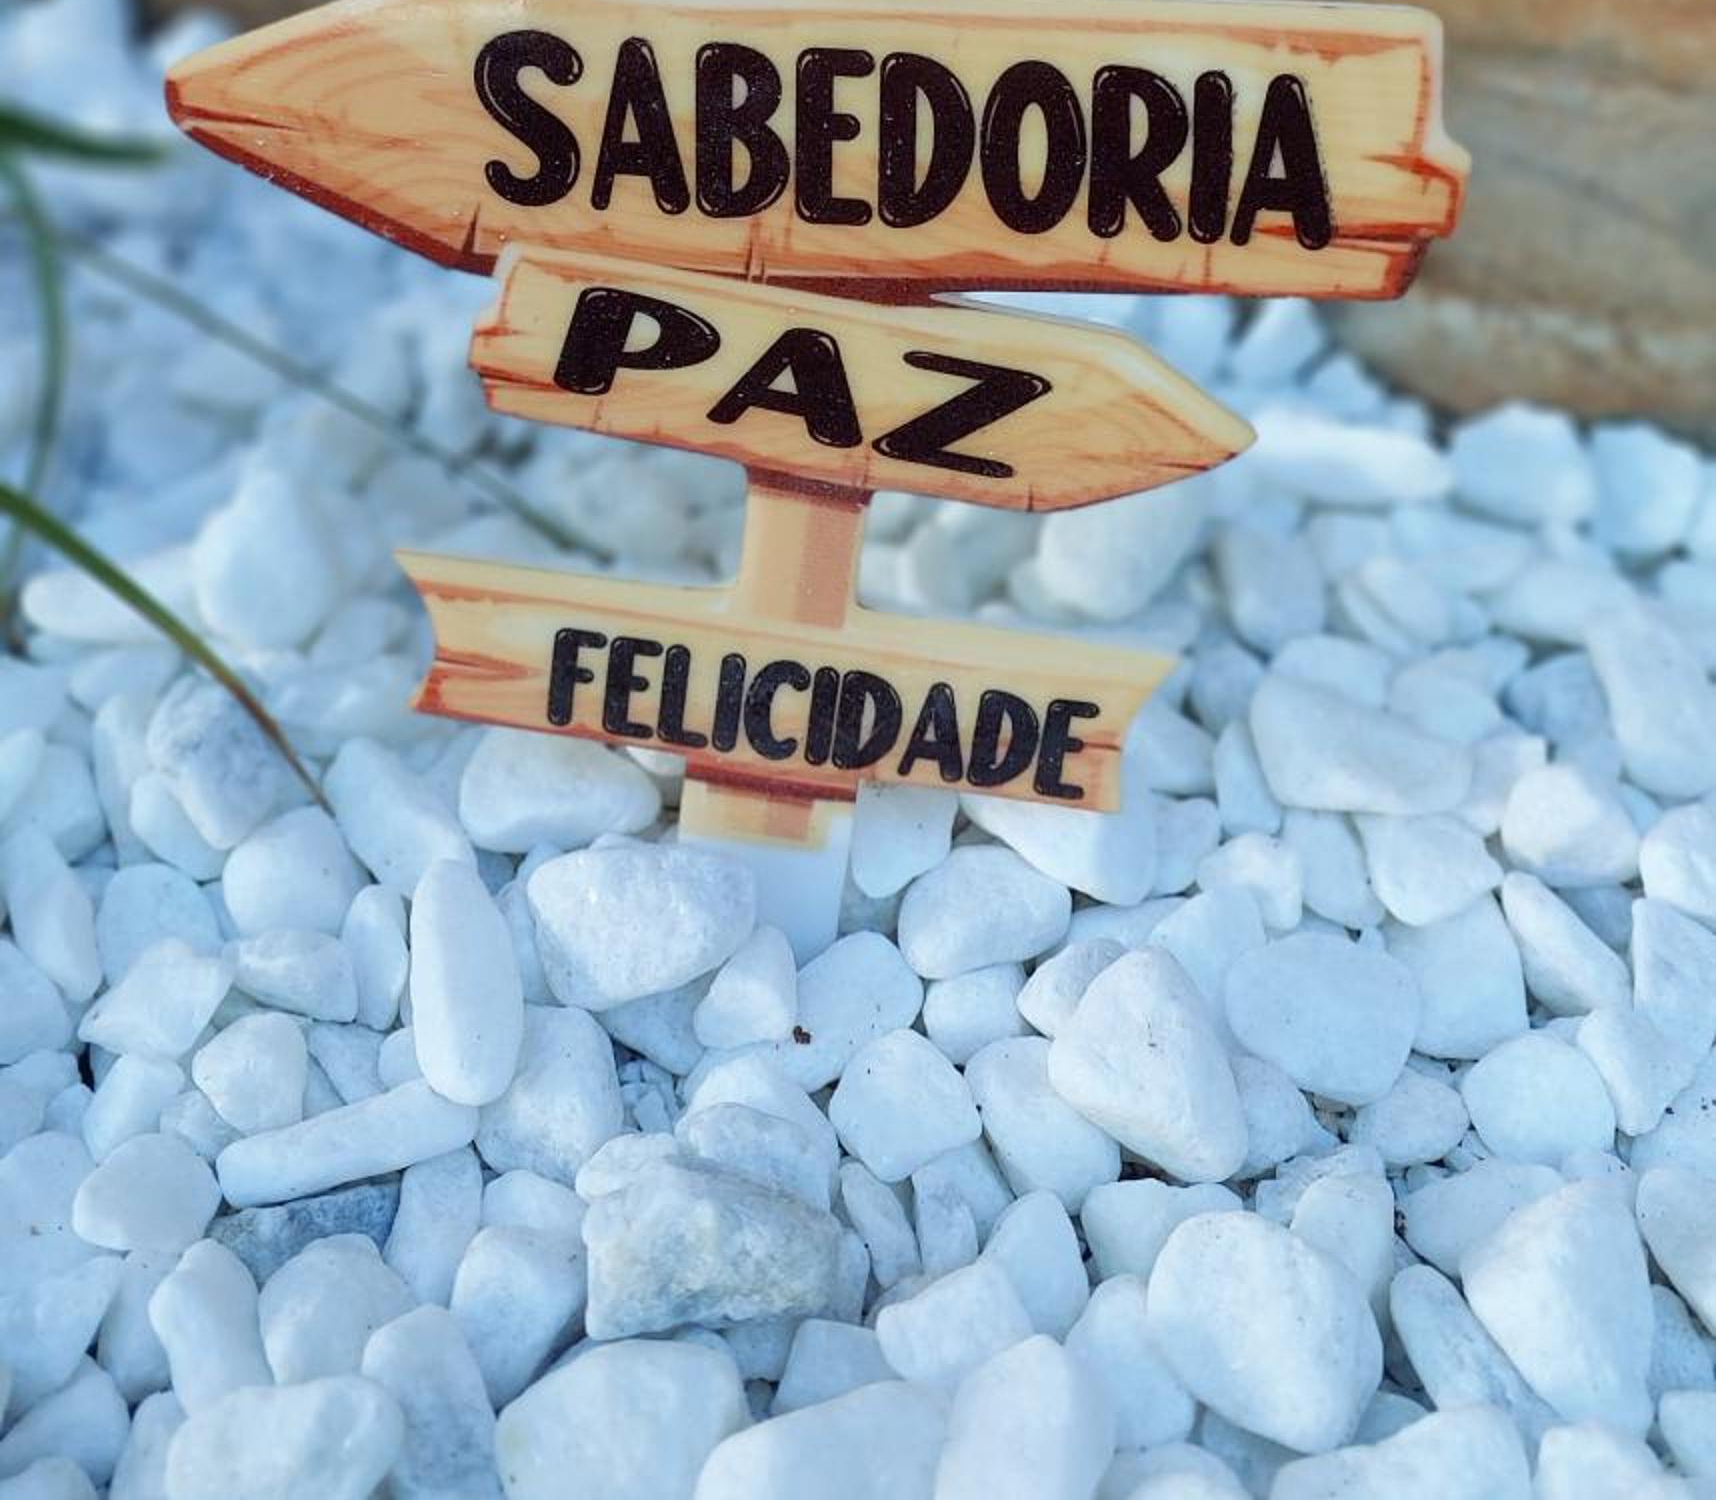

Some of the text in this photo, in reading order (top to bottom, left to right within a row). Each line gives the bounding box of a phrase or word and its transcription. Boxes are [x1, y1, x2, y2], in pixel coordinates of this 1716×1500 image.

[474, 29, 1336, 251] SABEDORIA
[554, 286, 1053, 479] PAZ
[548, 627, 1100, 800] FELICIDADE
